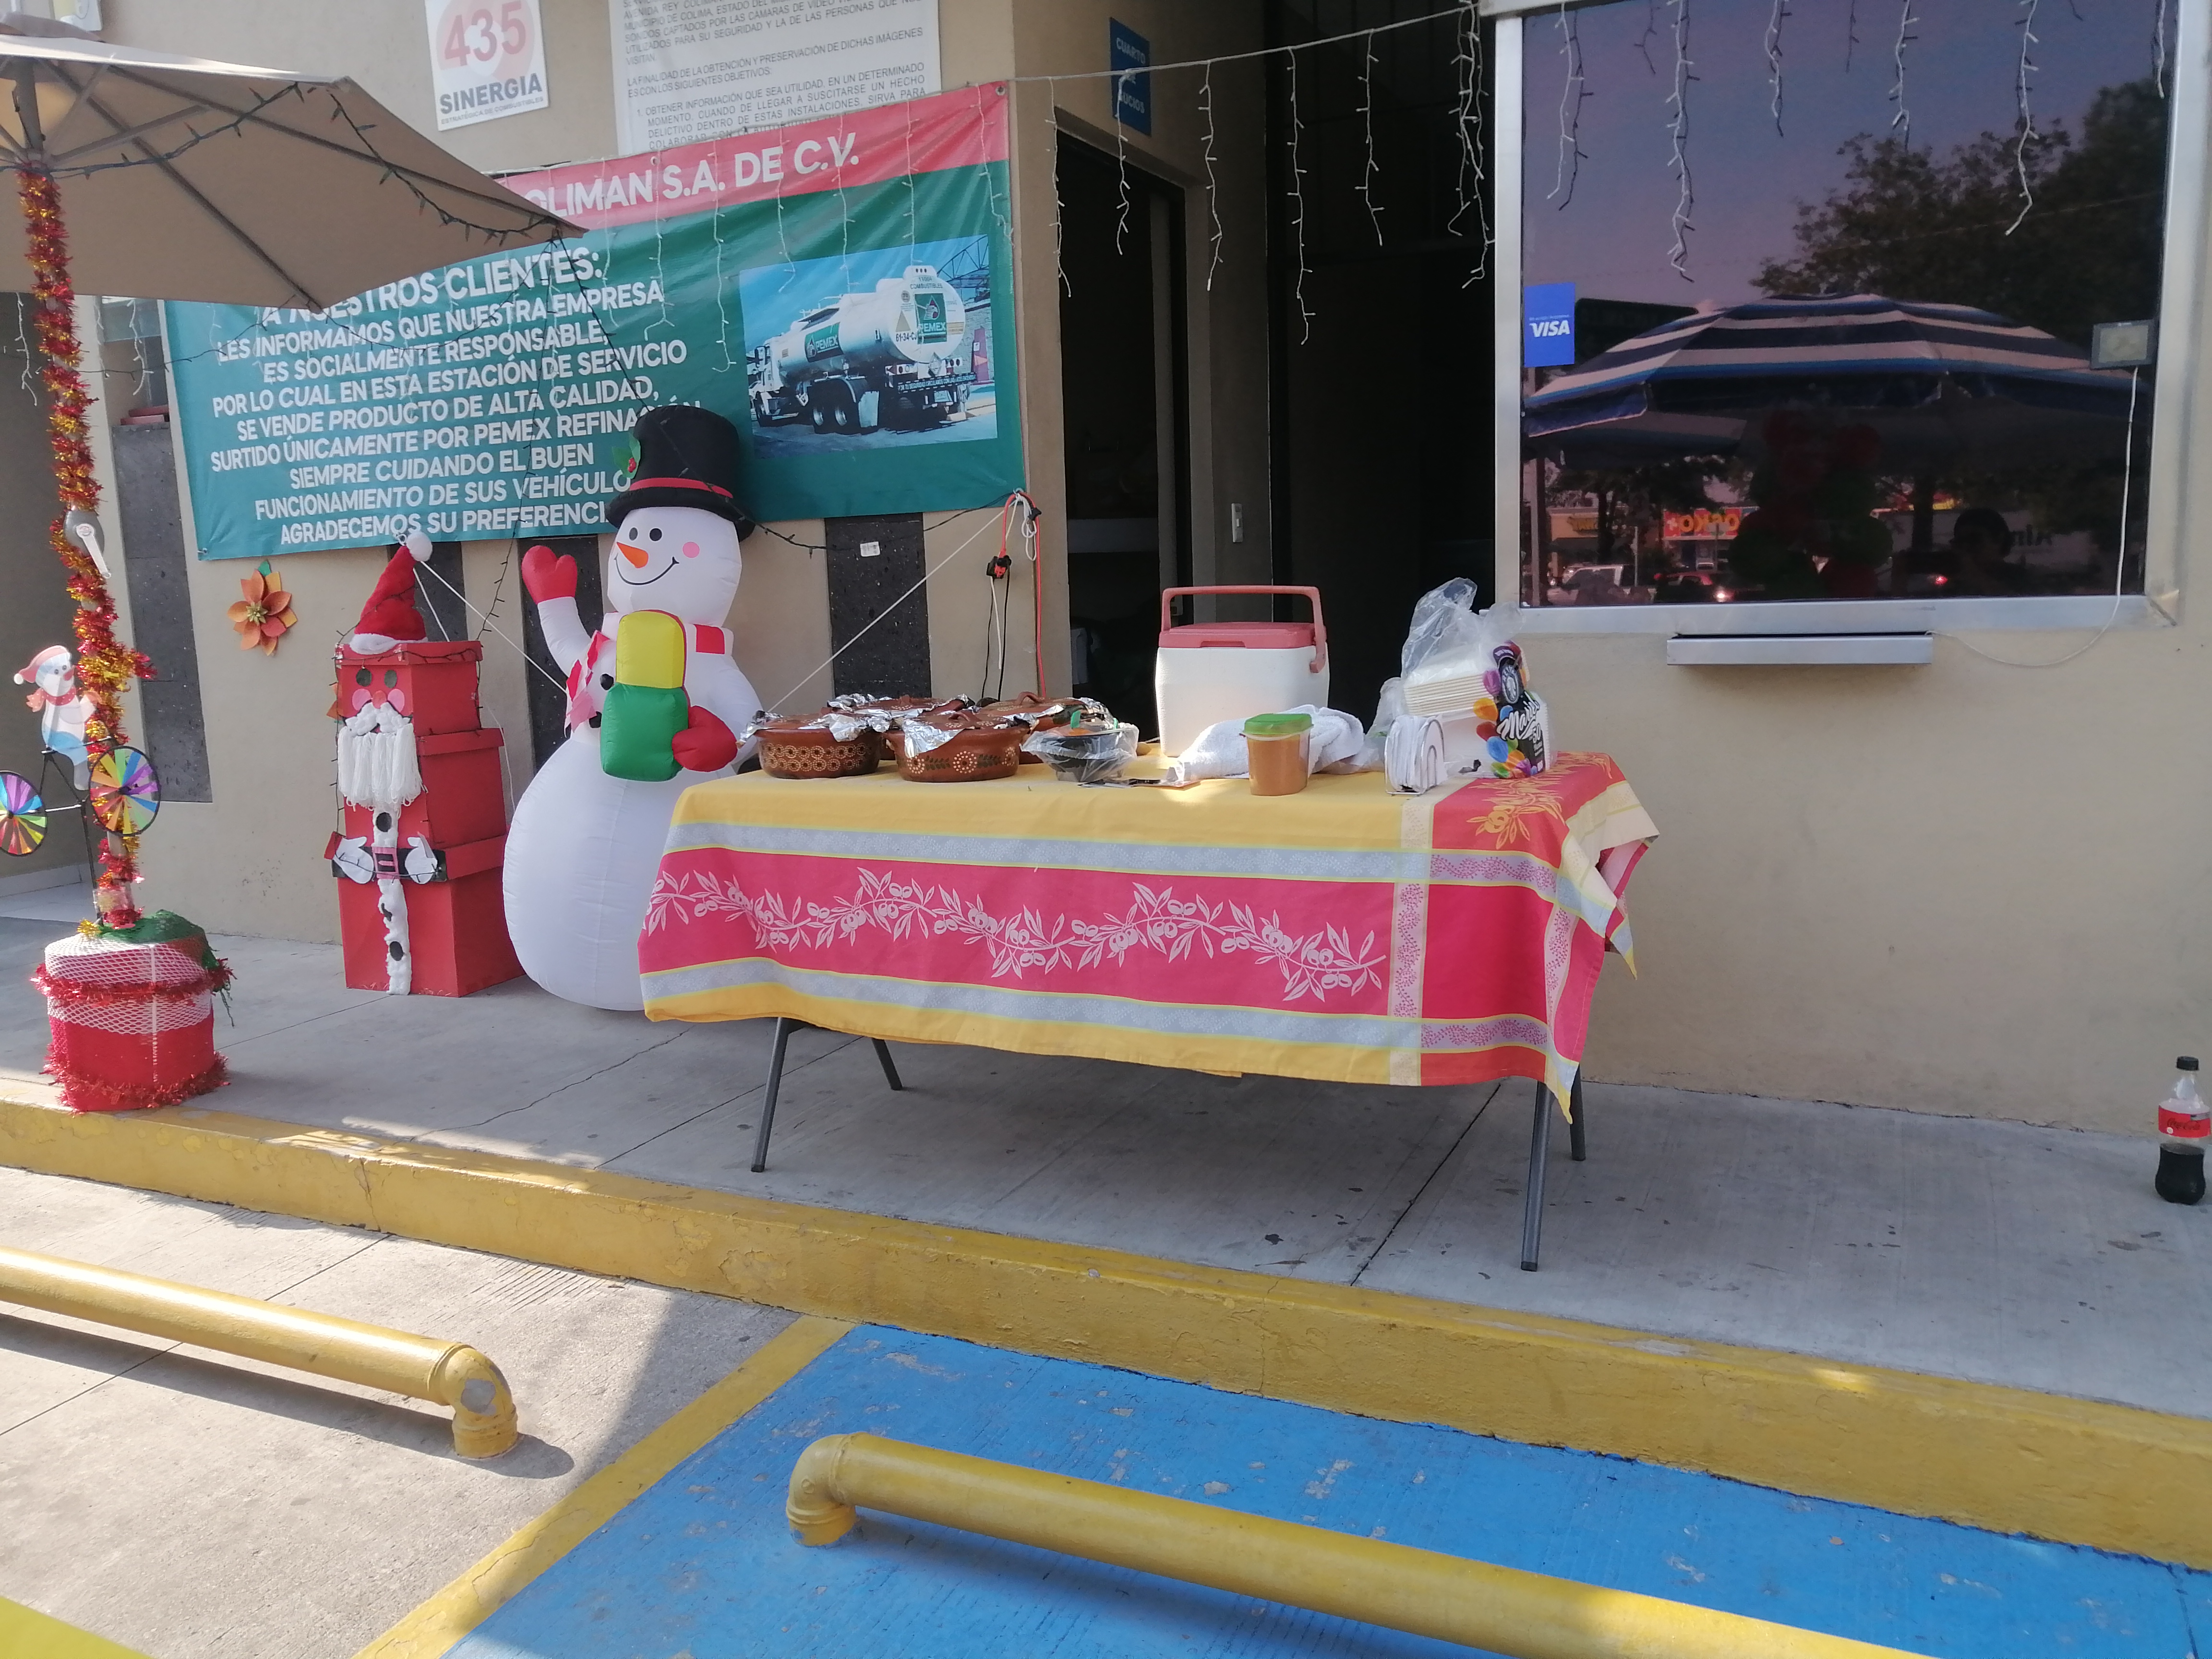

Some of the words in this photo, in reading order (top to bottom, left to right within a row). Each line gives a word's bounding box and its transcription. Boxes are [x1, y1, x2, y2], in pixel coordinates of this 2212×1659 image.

[662, 2, 678, 12] REY
[663, 20, 706, 36] CAPTADOS
[709, 16, 727, 28] POR
[730, 13, 745, 24] LAS
[793, 2, 804, 12] DE
[667, 13, 678, 23] DE
[717, 0, 749, 14] ESTADO
[675, 34, 696, 46] PARA
[699, 32, 710, 41] SU
[714, 22, 763, 38] SEGURIDAD
[766, 20, 772, 28] Y
[776, 18, 786, 27] LA
[789, 14, 801, 24] DE
[805, 11, 821, 22] LAS
[826, 1, 875, 18] PERSONAS
[445, 1, 526, 66] 435
[627, 77, 637, 87] LA
[638, 71, 678, 84] FINALIDAD
[680, 68, 690, 78] DE
[693, 66, 703, 75] LA
[753, 56, 758, 65] Y
[828, 42, 839, 52] DE
[842, 36, 874, 50] DICHAS
[876, 27, 923, 44] IMÁGENES
[440, 73, 542, 114] SINERGIA
[628, 88, 638, 97] ES
[640, 86, 657, 96] CON
[658, 84, 672, 93] LOS
[675, 75, 723, 90] SIGUIENTES
[646, 101, 683, 116] OBTENER
[686, 93, 743, 110] INFORMACIÓN
[745, 89, 763, 100] QUE
[766, 87, 782, 96] SEA
[829, 76, 840, 86] EN
[843, 74, 855, 84] UN
[859, 62, 924, 81] DETERMINADO
[698, 106, 735, 119] CUANDO
[740, 102, 752, 112] DE
[757, 96, 792, 110] LLEGAR
[797, 95, 803, 104] A
[807, 84, 866, 102] SUSCITARSE
[872, 82, 885, 91] UN
[890, 74, 925, 88] HECHO
[1119, 90, 1145, 113] UCIOS
[649, 124, 692, 138] DELICTIVO
[697, 117, 733, 132] DENTRO
[738, 115, 749, 125] DE
[755, 110, 783, 122] ESTAS
[868, 93, 896, 104] SIRVA
[901, 87, 926, 97] PARA
[663, 159, 725, 199] S.A.
[734, 146, 783, 187] DE
[794, 133, 859, 175] C.V.
[262, 307, 282, 327] A
[289, 272, 439, 324] NESTROS
[445, 247, 603, 300] CLIENTES:
[217, 338, 251, 362] LES
[256, 321, 394, 357] INFORMAMOS
[398, 313, 443, 339] QUE
[445, 297, 547, 332] NUESTRA
[552, 280, 663, 317] EMPRESA
[815, 335, 838, 351] PEMEX
[1529, 320, 1570, 337] VISA
[264, 361, 289, 384] ES
[294, 341, 441, 380] SOCIALMENTE
[445, 319, 609, 363] RESPONSABLE,
[213, 395, 249, 418] POR
[252, 389, 274, 412] LO
[278, 385, 336, 408] CUAL
[341, 378, 367, 403] EN
[372, 373, 420, 400] ESTA
[428, 354, 538, 393] ESTACIÓN
[542, 355, 573, 380] DE
[577, 339, 687, 376] SERVICIO
[237, 420, 258, 441] SE
[259, 411, 324, 437] VENDE
[329, 398, 449, 431] PRODUCTO
[454, 395, 483, 419] DE
[488, 388, 544, 416] ALTA
[550, 376, 659, 410] CALIDAD,
[211, 444, 280, 472] SURTIDO
[284, 430, 419, 462] ÚNICAMENTE
[423, 426, 469, 450] POR
[474, 417, 552, 446] PEMEX
[557, 395, 700, 438] REFINA
[289, 462, 370, 490] SIEMPRE
[375, 453, 494, 482] CUIDANDO
[499, 450, 526, 473] EL
[531, 442, 594, 470] BUEN
[255, 486, 424, 520] FUNCIONAMIENTO
[429, 483, 459, 505] DE
[464, 481, 506, 504] SUS
[280, 513, 421, 545] AGRADECEMOS
[427, 511, 457, 533] SU
[463, 501, 609, 532] PREFERENCI
